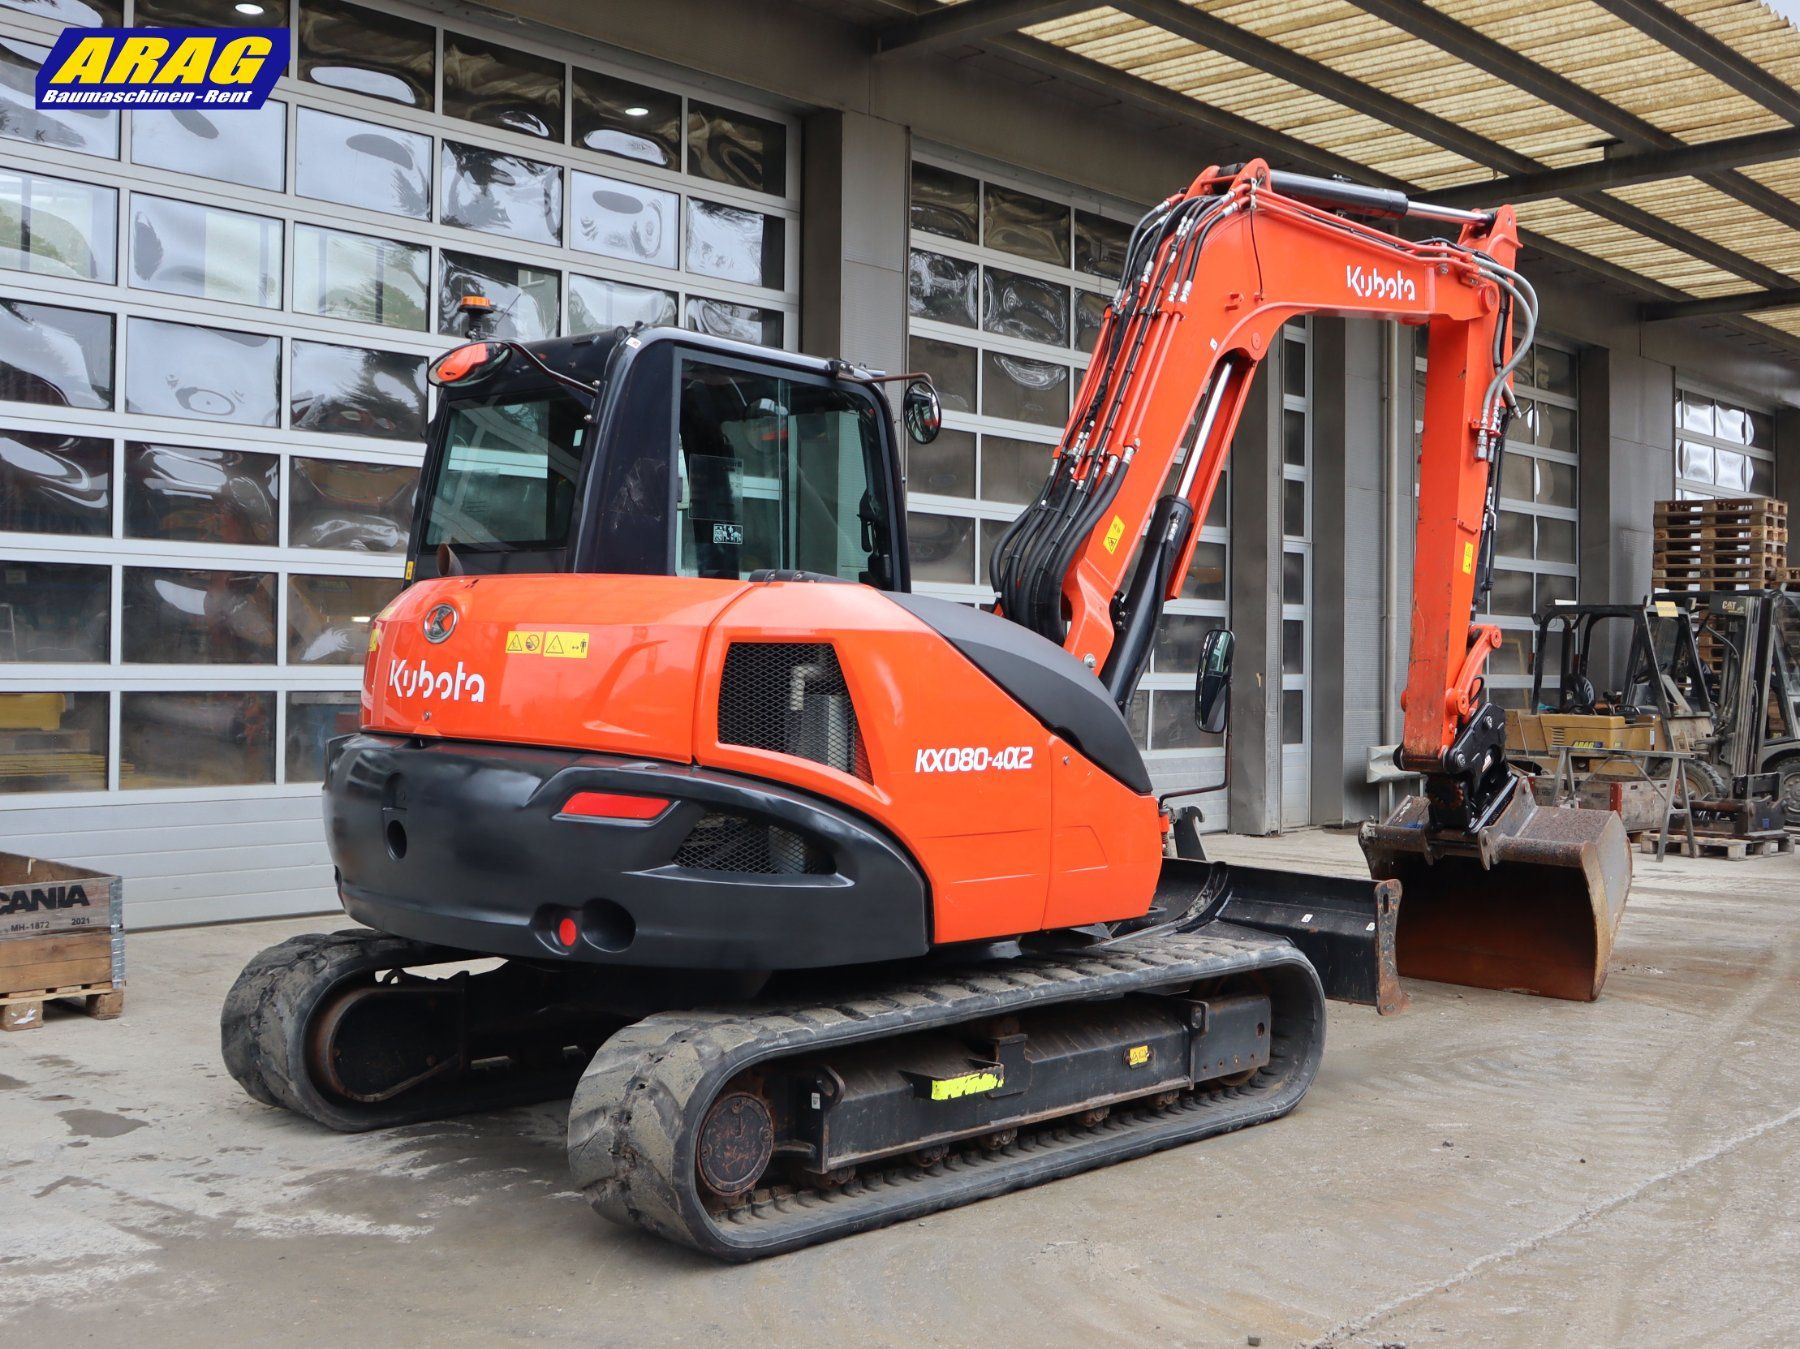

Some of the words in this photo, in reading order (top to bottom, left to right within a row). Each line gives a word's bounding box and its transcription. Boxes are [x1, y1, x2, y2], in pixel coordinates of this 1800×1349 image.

[1346, 265, 1416, 301] Kubota
[1722, 601, 1737, 610] CAT
[389, 660, 485, 702] Kubota
[11, 921, 50, 932] MH-1872
[71, 918, 90, 926] 2021
